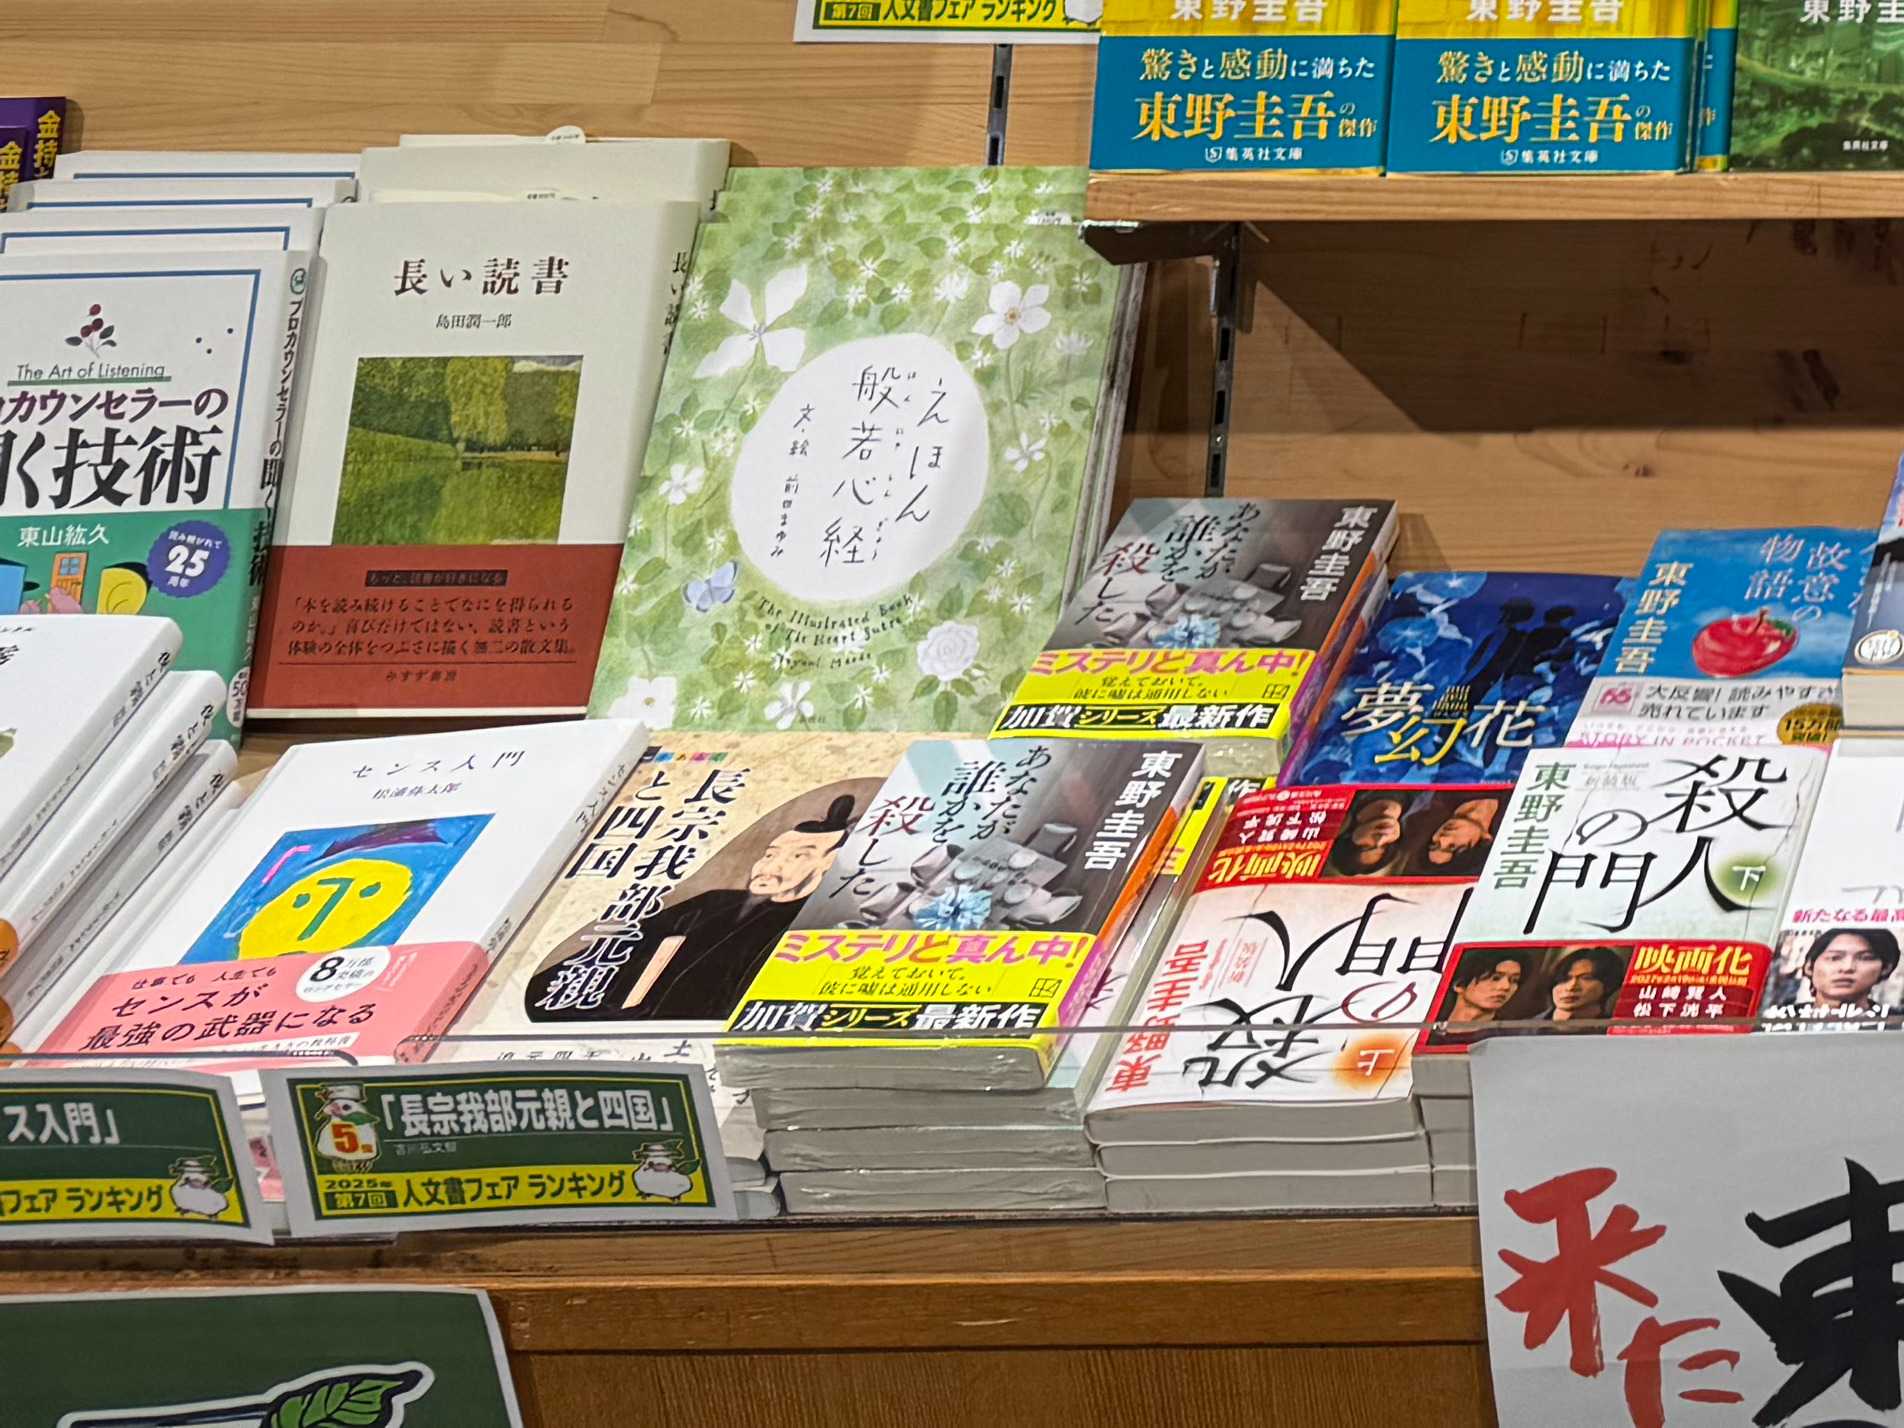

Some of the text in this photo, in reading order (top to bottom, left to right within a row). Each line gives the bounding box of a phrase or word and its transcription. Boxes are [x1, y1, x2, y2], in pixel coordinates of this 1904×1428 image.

[1140, 48, 1376, 85] 驚きと感動に満ちた
[1133, 90, 1378, 144] 東野圭吾の傑作
[392, 254, 571, 298] 長い読書
[435, 311, 513, 332] 島田潤一郎
[20, 525, 112, 546] 東山紘久
[1341, 681, 1546, 766] 夢幻花
[351, 749, 527, 780] センス入門
[1631, 754, 1789, 913] 殺人
[1522, 808, 1653, 934] の門
[1633, 944, 1752, 977] 映画化
[110, 981, 262, 1014] センスが
[380, 1091, 677, 1136] 「長宗我部元親と四国」
